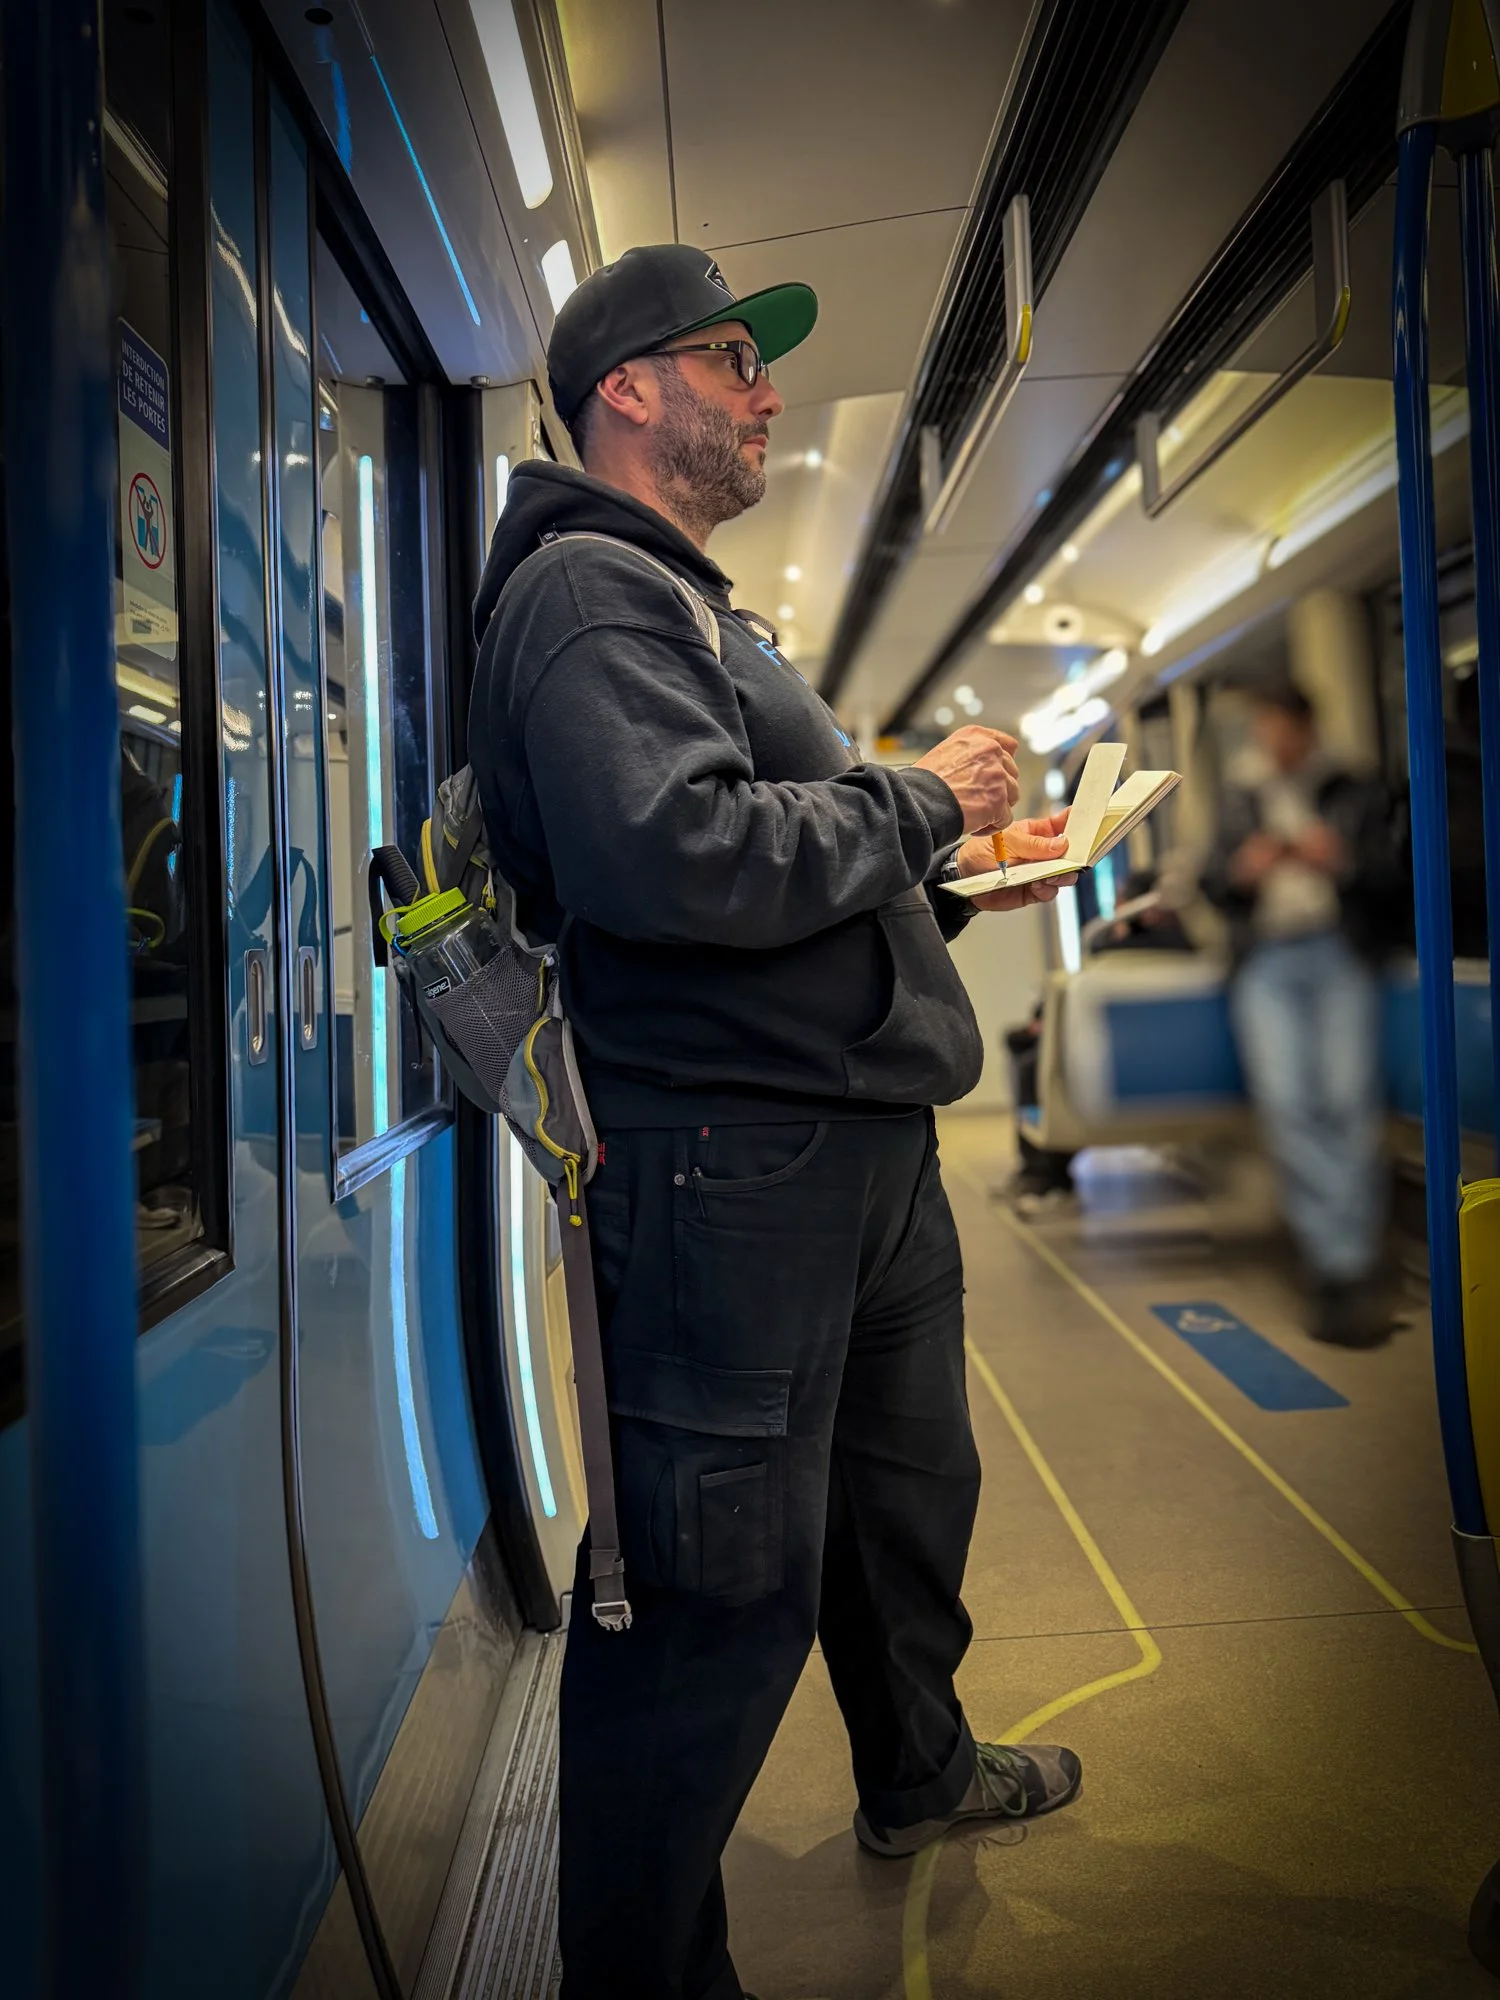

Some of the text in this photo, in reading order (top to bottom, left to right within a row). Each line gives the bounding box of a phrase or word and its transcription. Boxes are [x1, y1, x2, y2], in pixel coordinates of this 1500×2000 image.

[121, 338, 165, 391] INTERDICTION
[122, 360, 165, 413] DE RETENIR
[123, 382, 166, 434] LES PORTES
